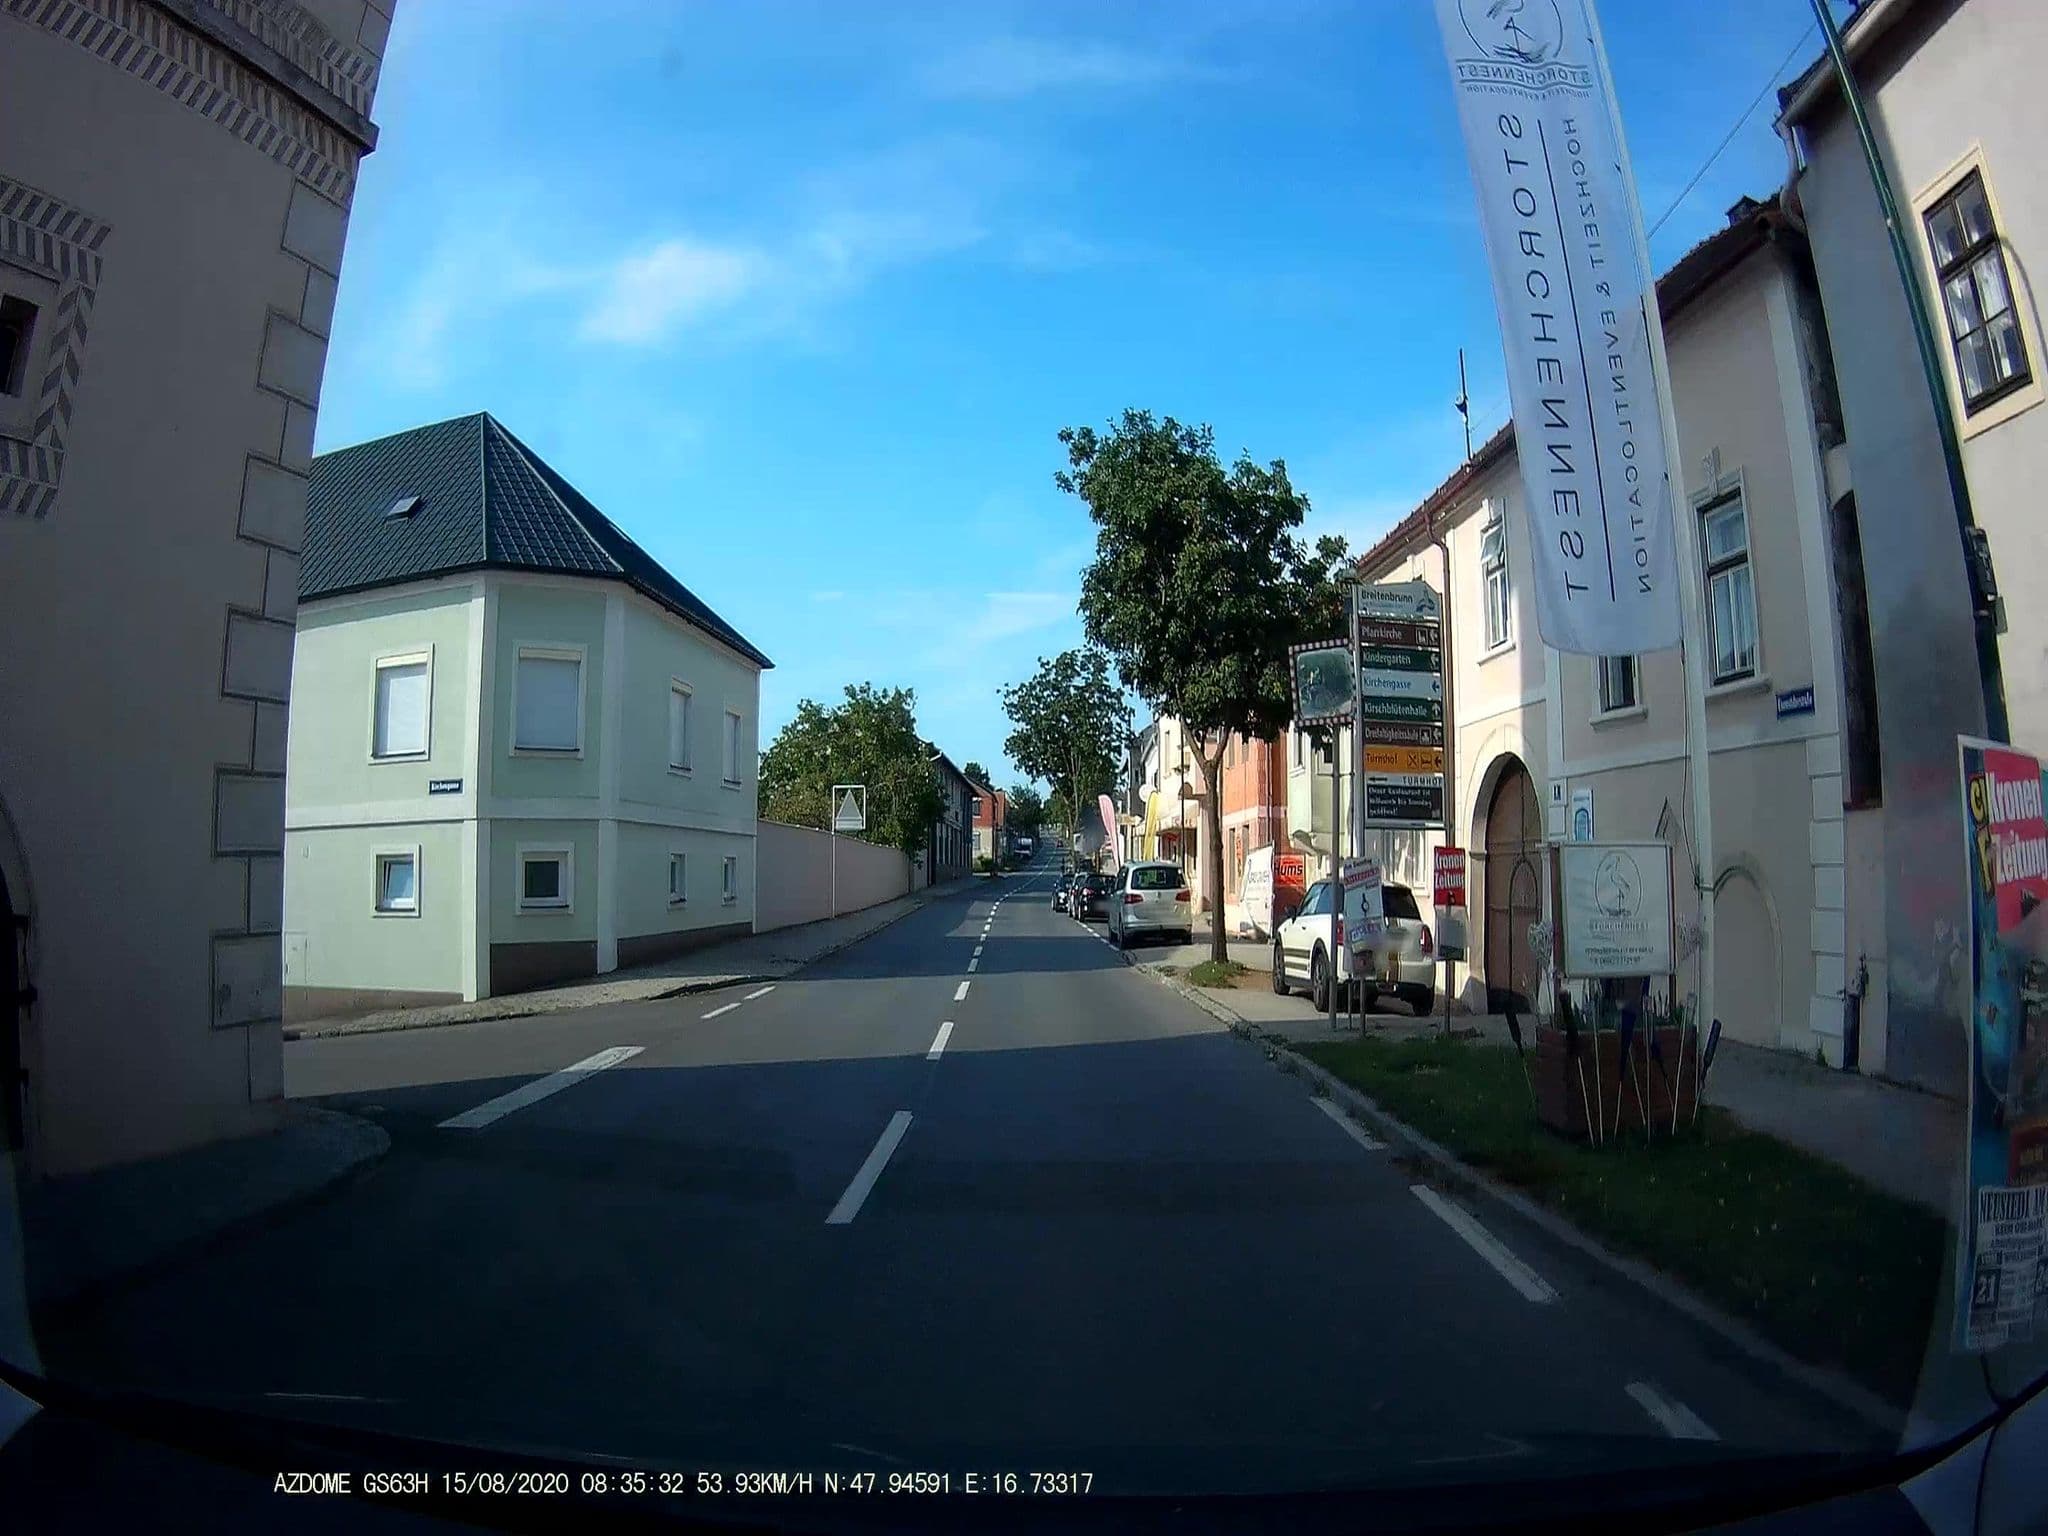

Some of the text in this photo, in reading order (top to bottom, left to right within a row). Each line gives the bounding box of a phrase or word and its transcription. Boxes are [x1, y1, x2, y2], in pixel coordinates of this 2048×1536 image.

[1361, 589, 1413, 602] Breitenbrunn
[1362, 651, 1411, 666] Kindergarten
[1363, 676, 1411, 691] Kirchengasse
[1364, 702, 1428, 717] Kirschblütenhalle
[1402, 776, 1443, 786] TURMHOF
[1985, 771, 2043, 824] Kronen
[1435, 852, 1465, 870] Kronen
[1991, 830, 2048, 884] Zeitung
[1435, 871, 1465, 890] Zeitung
[1975, 1274, 1997, 1304] 21
